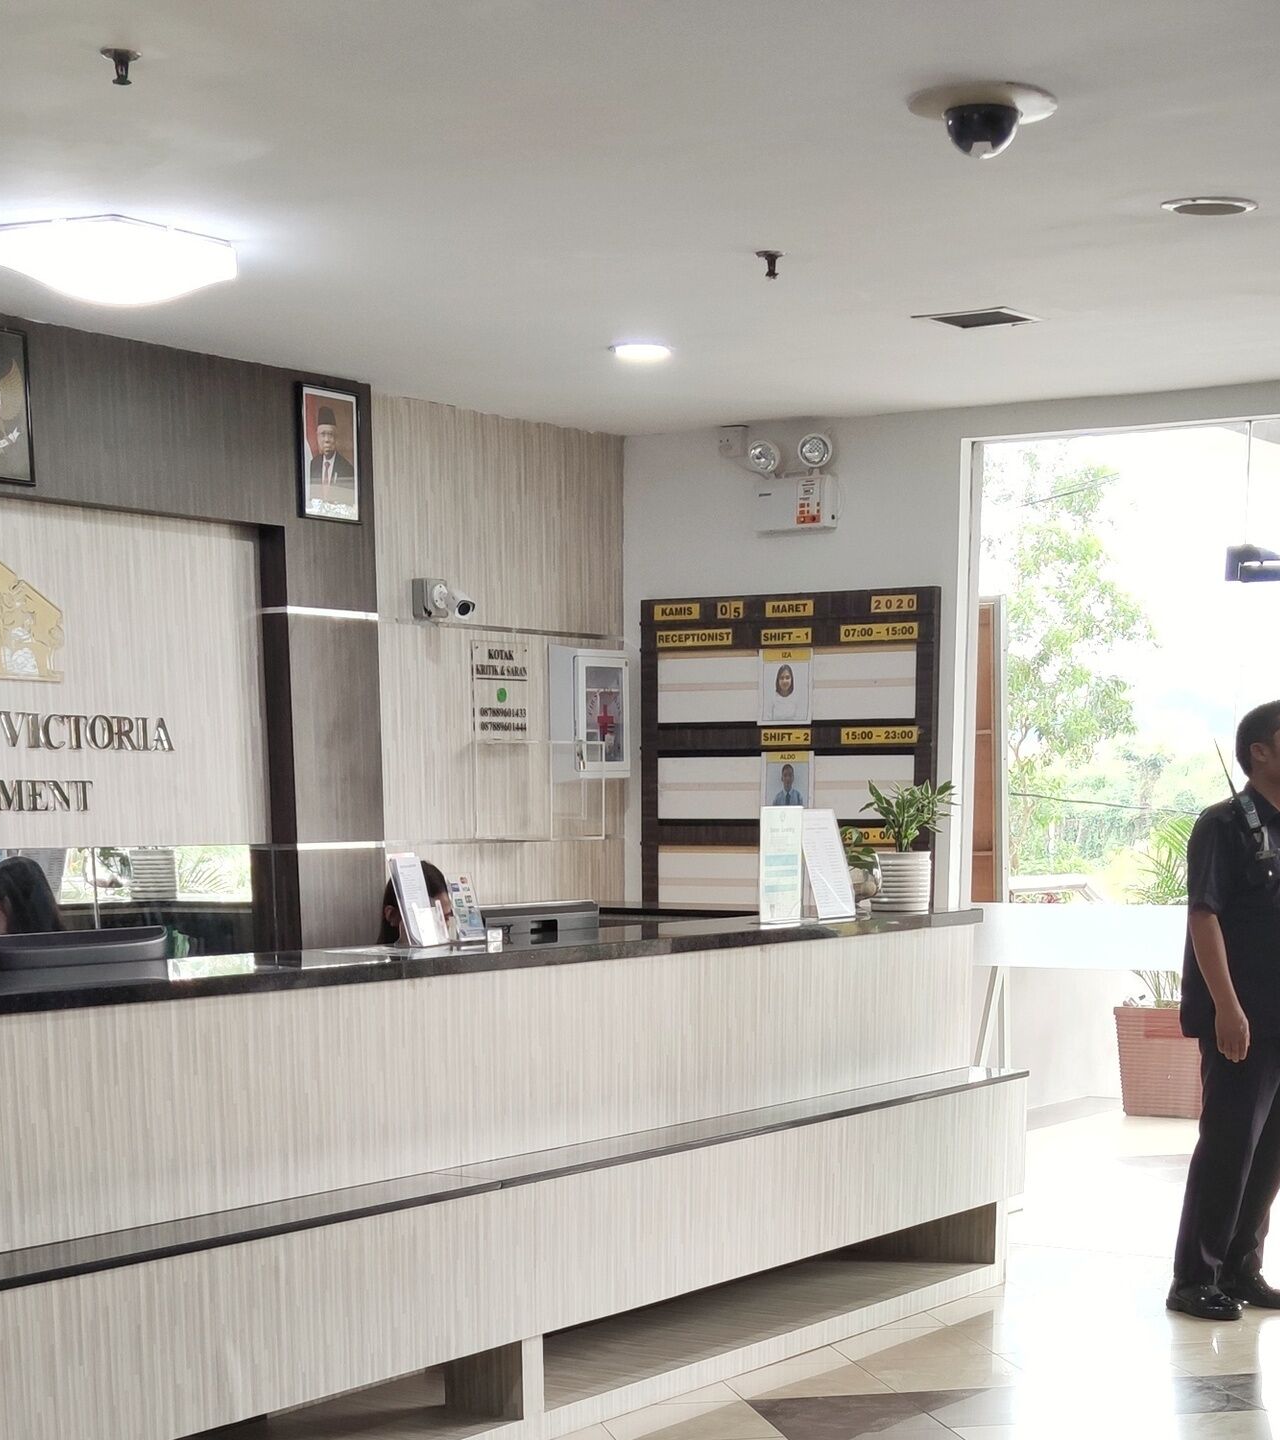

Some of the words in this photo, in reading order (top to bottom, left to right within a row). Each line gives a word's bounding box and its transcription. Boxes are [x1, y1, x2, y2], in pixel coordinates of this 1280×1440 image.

[661, 606, 693, 617] KAMIS
[720, 604, 741, 618] 05
[771, 603, 808, 613] MARET
[658, 631, 731, 644] RECEPTIONIST
[763, 631, 793, 642] SHIFT
[843, 627, 873, 638] 07:00
[885, 625, 915, 636] 15:00
[488, 648, 514, 661] KOTAK
[475, 664, 499, 676] KRITIK
[506, 666, 527, 677] SARAN
[763, 732, 793, 742] SHIFT
[803, 732, 809, 742] 2
[845, 730, 873, 740] 15:00
[884, 730, 914, 740] 23:00
